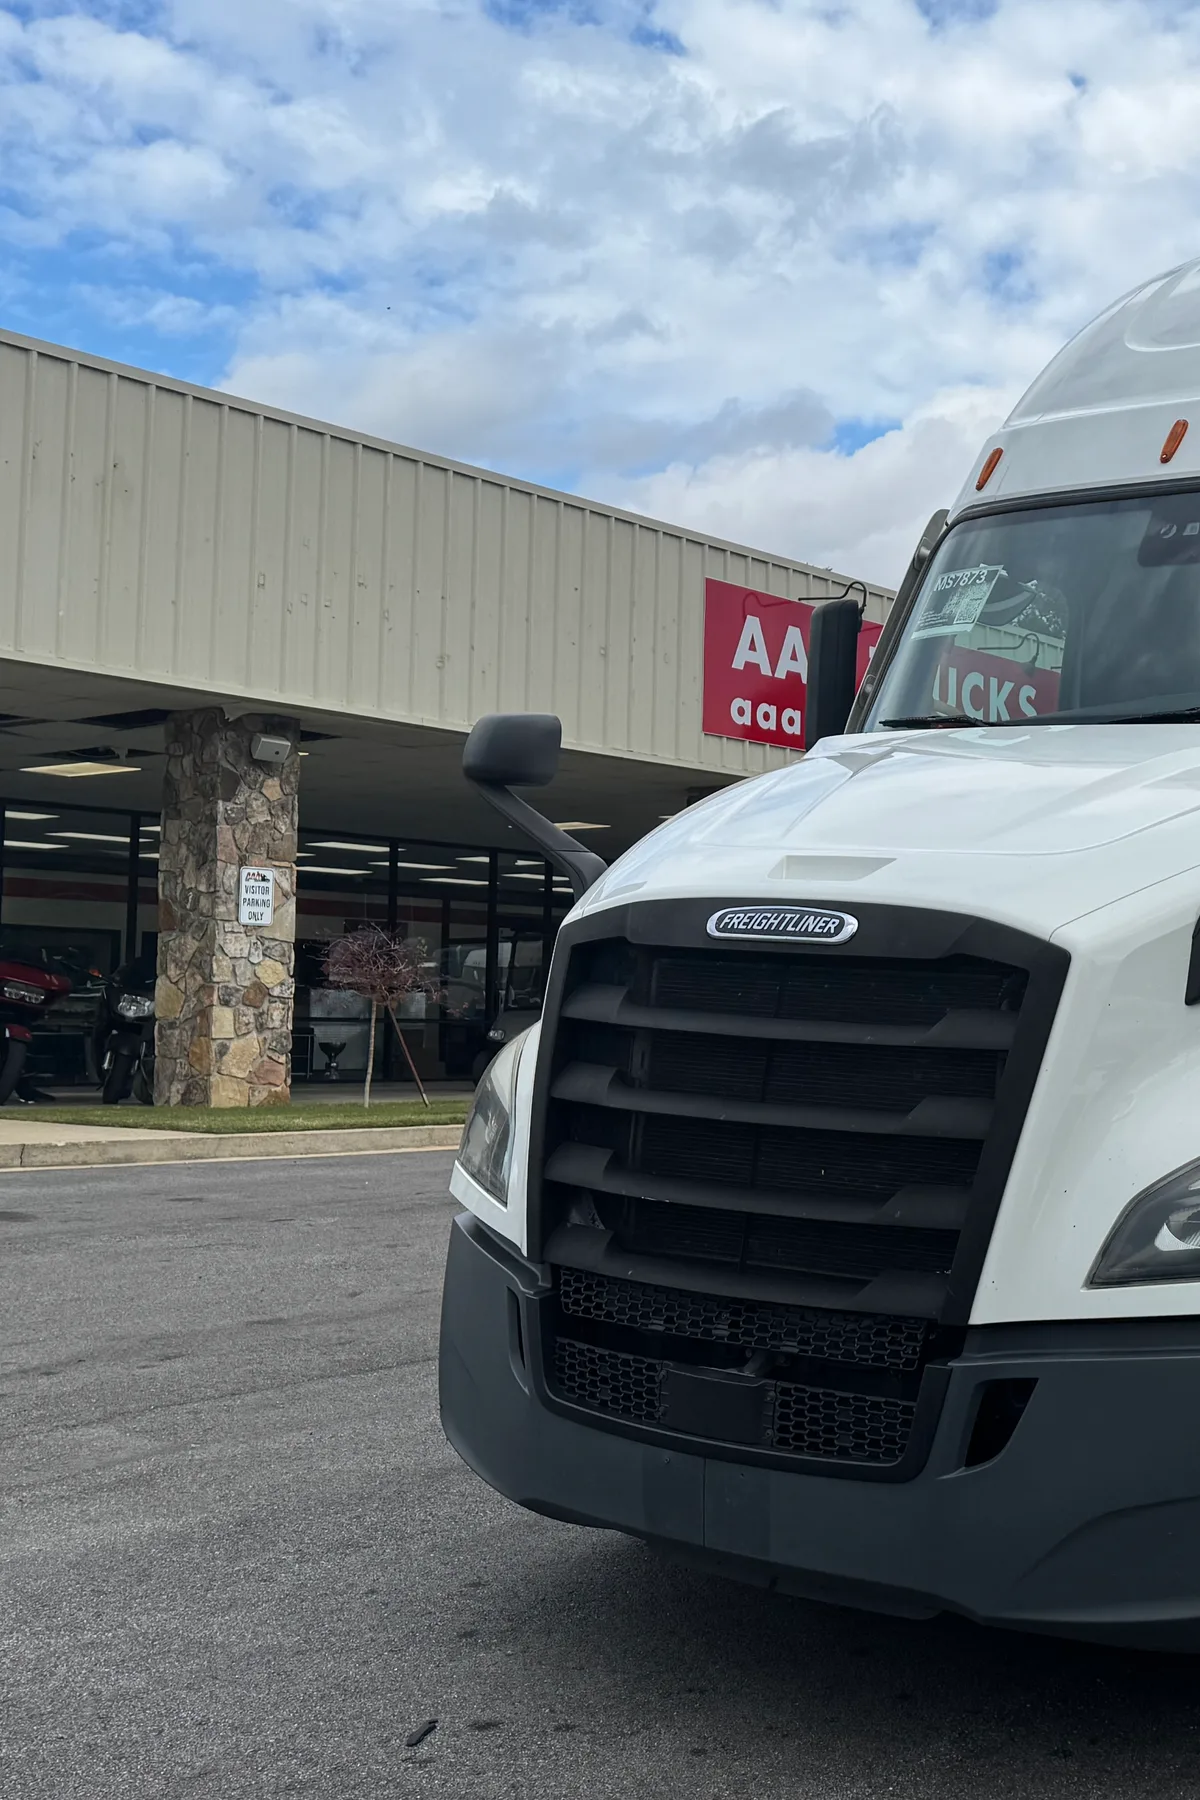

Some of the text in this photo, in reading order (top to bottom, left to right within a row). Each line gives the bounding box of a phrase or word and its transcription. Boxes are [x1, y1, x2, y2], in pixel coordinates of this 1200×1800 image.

[933, 570, 988, 591] MS7873
[244, 885, 270, 895] VISITOR
[242, 897, 271, 908] PARKING
[248, 911, 264, 921] ONLY
[719, 913, 840, 934] FREIGHTLINER
